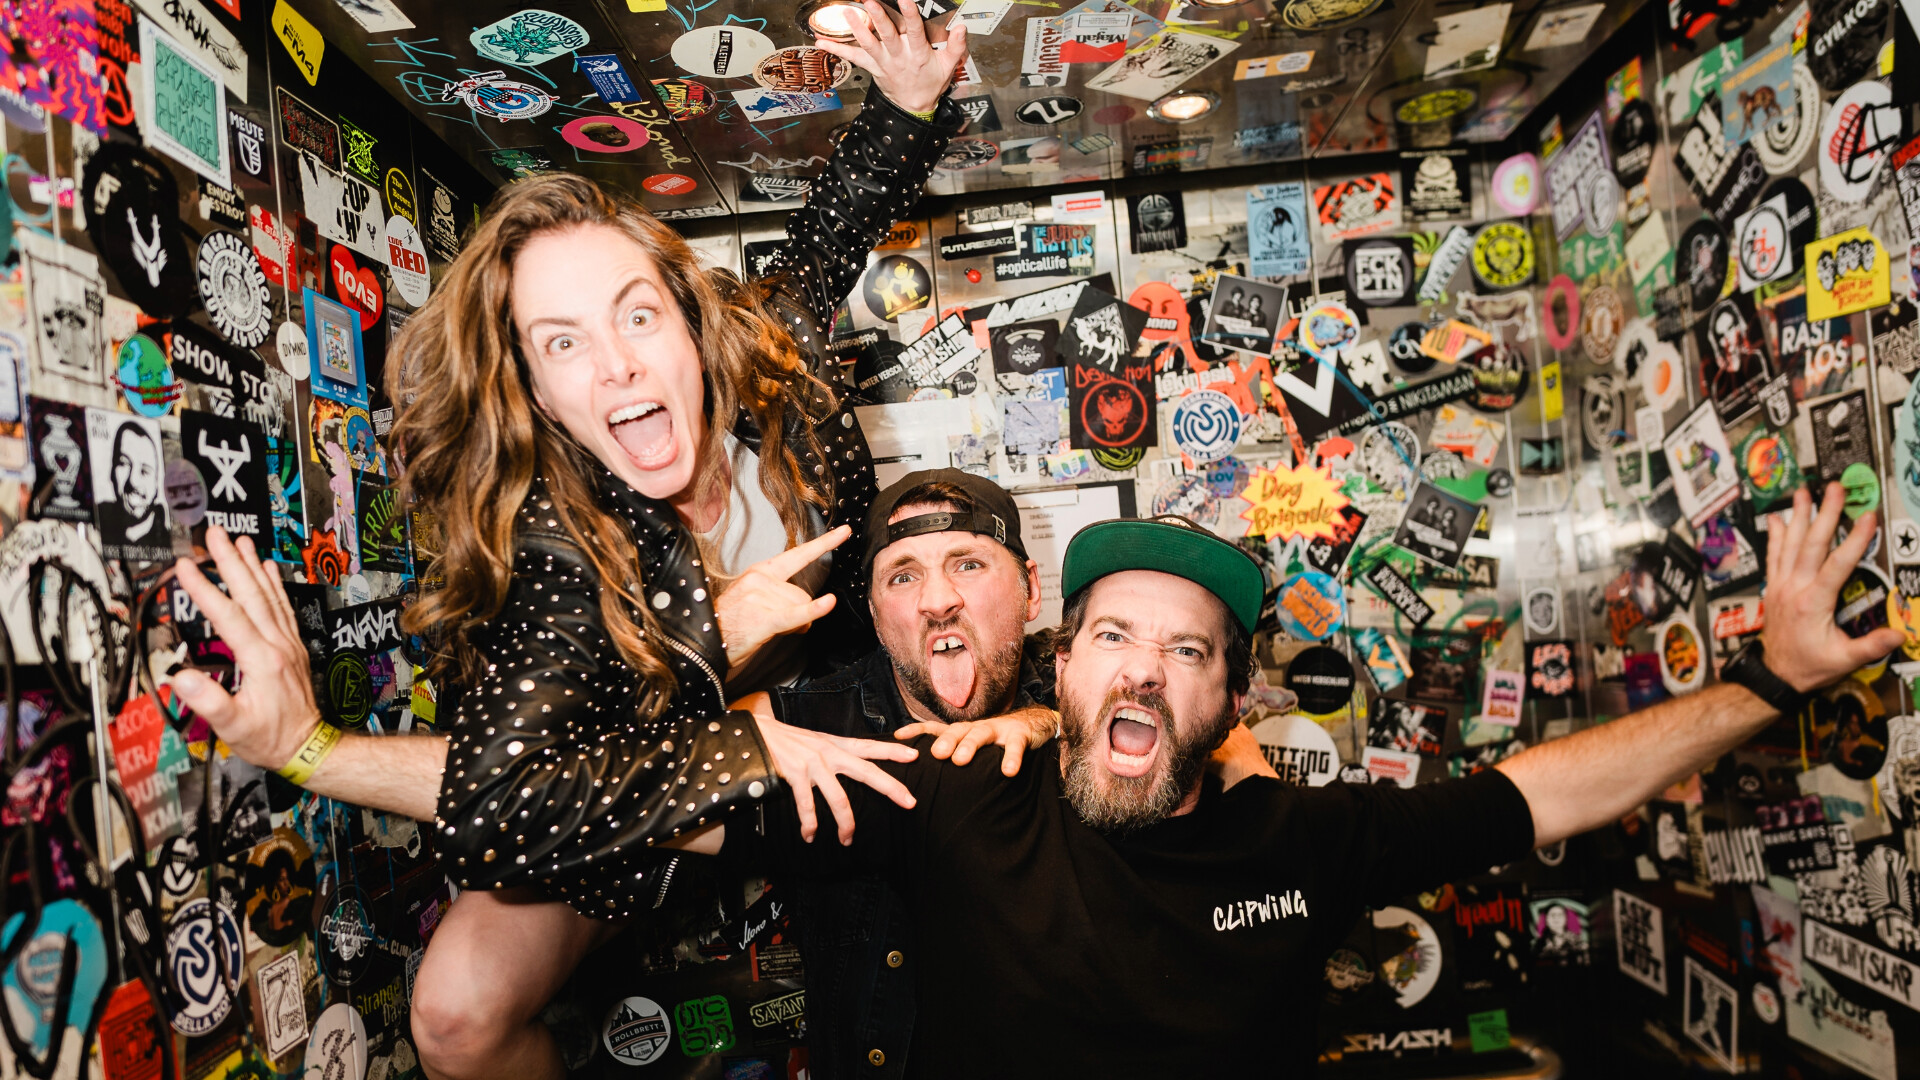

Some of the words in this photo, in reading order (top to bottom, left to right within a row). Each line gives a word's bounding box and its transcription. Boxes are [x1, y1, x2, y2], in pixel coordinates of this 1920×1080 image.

[281, 26, 316, 78] FM4
[1037, 24, 1062, 75] ASCOW
[229, 111, 265, 143] MEUTE
[389, 243, 426, 275] RED
[941, 235, 1015, 254] FUTUREBEATZ
[996, 256, 1068, 277] #opticallife
[1356, 255, 1402, 275] FCK
[1357, 274, 1405, 291] PTN
[899, 328, 944, 368] PARTY
[172, 334, 234, 387] SHOW
[240, 370, 276, 402] STO
[877, 363, 904, 382] VERSCH
[1399, 370, 1476, 411] NIKITAMAN
[1206, 470, 1235, 484] LOV
[1262, 475, 1304, 507] Dog
[1254, 499, 1335, 534] Brigade
[413, 684, 437, 704] HITC
[116, 706, 161, 740] KOC
[299, 722, 337, 766] AREN
[753, 996, 805, 1024] SAVANT
[614, 1022, 661, 1044] ROLLBRETT
